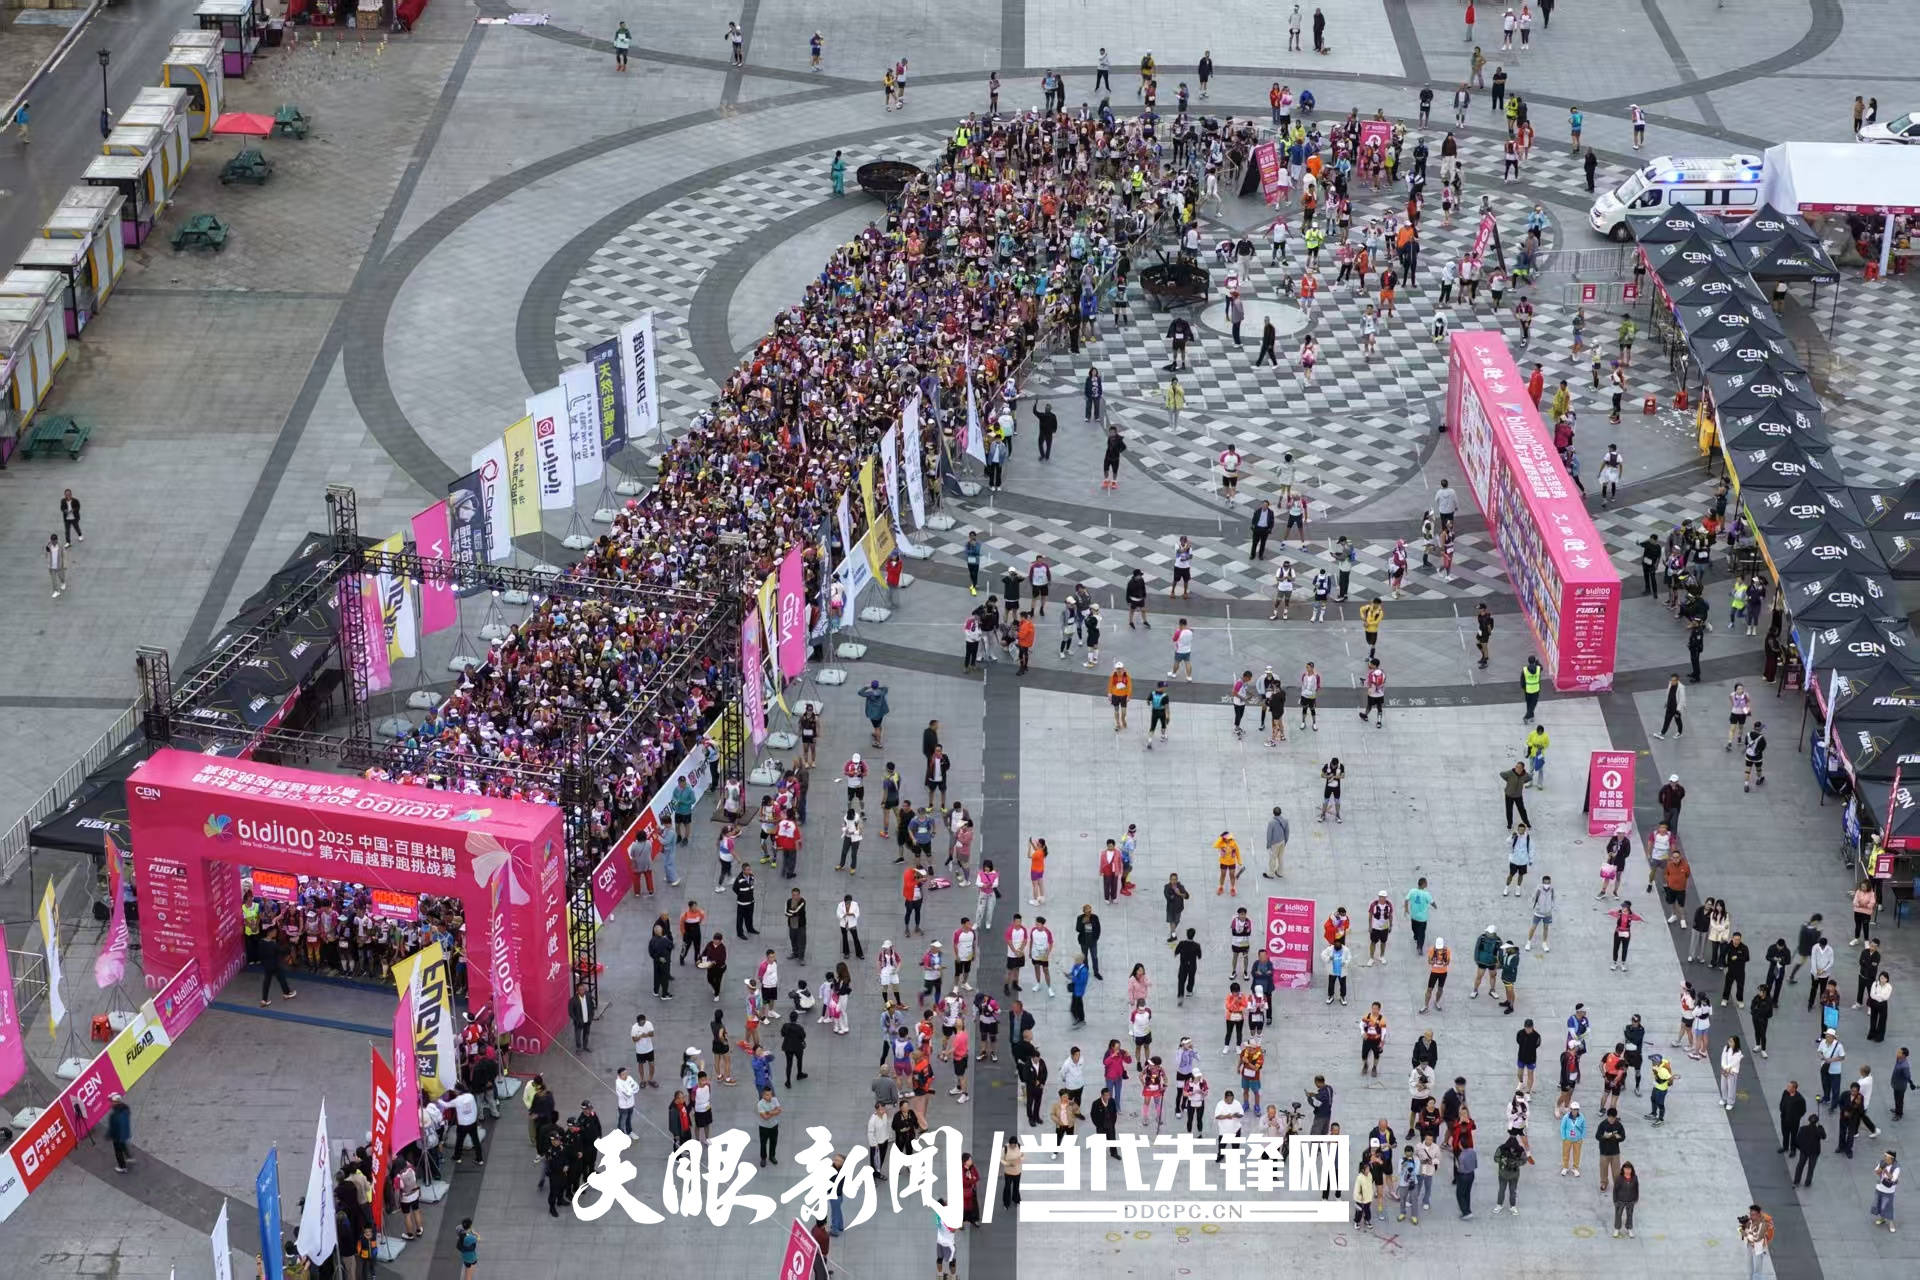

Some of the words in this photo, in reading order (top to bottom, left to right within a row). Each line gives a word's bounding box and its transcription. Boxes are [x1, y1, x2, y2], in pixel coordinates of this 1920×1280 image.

[1665, 219, 1695, 229] CBN
[1755, 220, 1784, 230] CBN
[1682, 252, 1712, 261] CBN
[1776, 258, 1802, 266] FUGA
[1701, 282, 1732, 292] CBN
[1718, 314, 1749, 324] CBN
[1736, 349, 1768, 359] CBN
[1750, 384, 1783, 396] CBN
[1758, 422, 1792, 434] CBN
[1771, 461, 1806, 473] CBN
[1789, 504, 1826, 515] CBN
[1811, 545, 1848, 556] CBN
[1828, 592, 1865, 606] CBN
[1847, 641, 1886, 654] CBN
[1872, 697, 1908, 706] FUGA
[135, 786, 161, 798] CBN
[76, 817, 112, 831] FUGA
[318, 830, 354, 846] 2025
[358, 834, 457, 863] 中国·百里杜鹃
[319, 844, 457, 880] 第六届越野跑挑战赛
[148, 864, 177, 875] FUGA
[598, 862, 617, 890] CBN
[126, 1034, 149, 1066] FUGA
[76, 1071, 104, 1105] CBN
